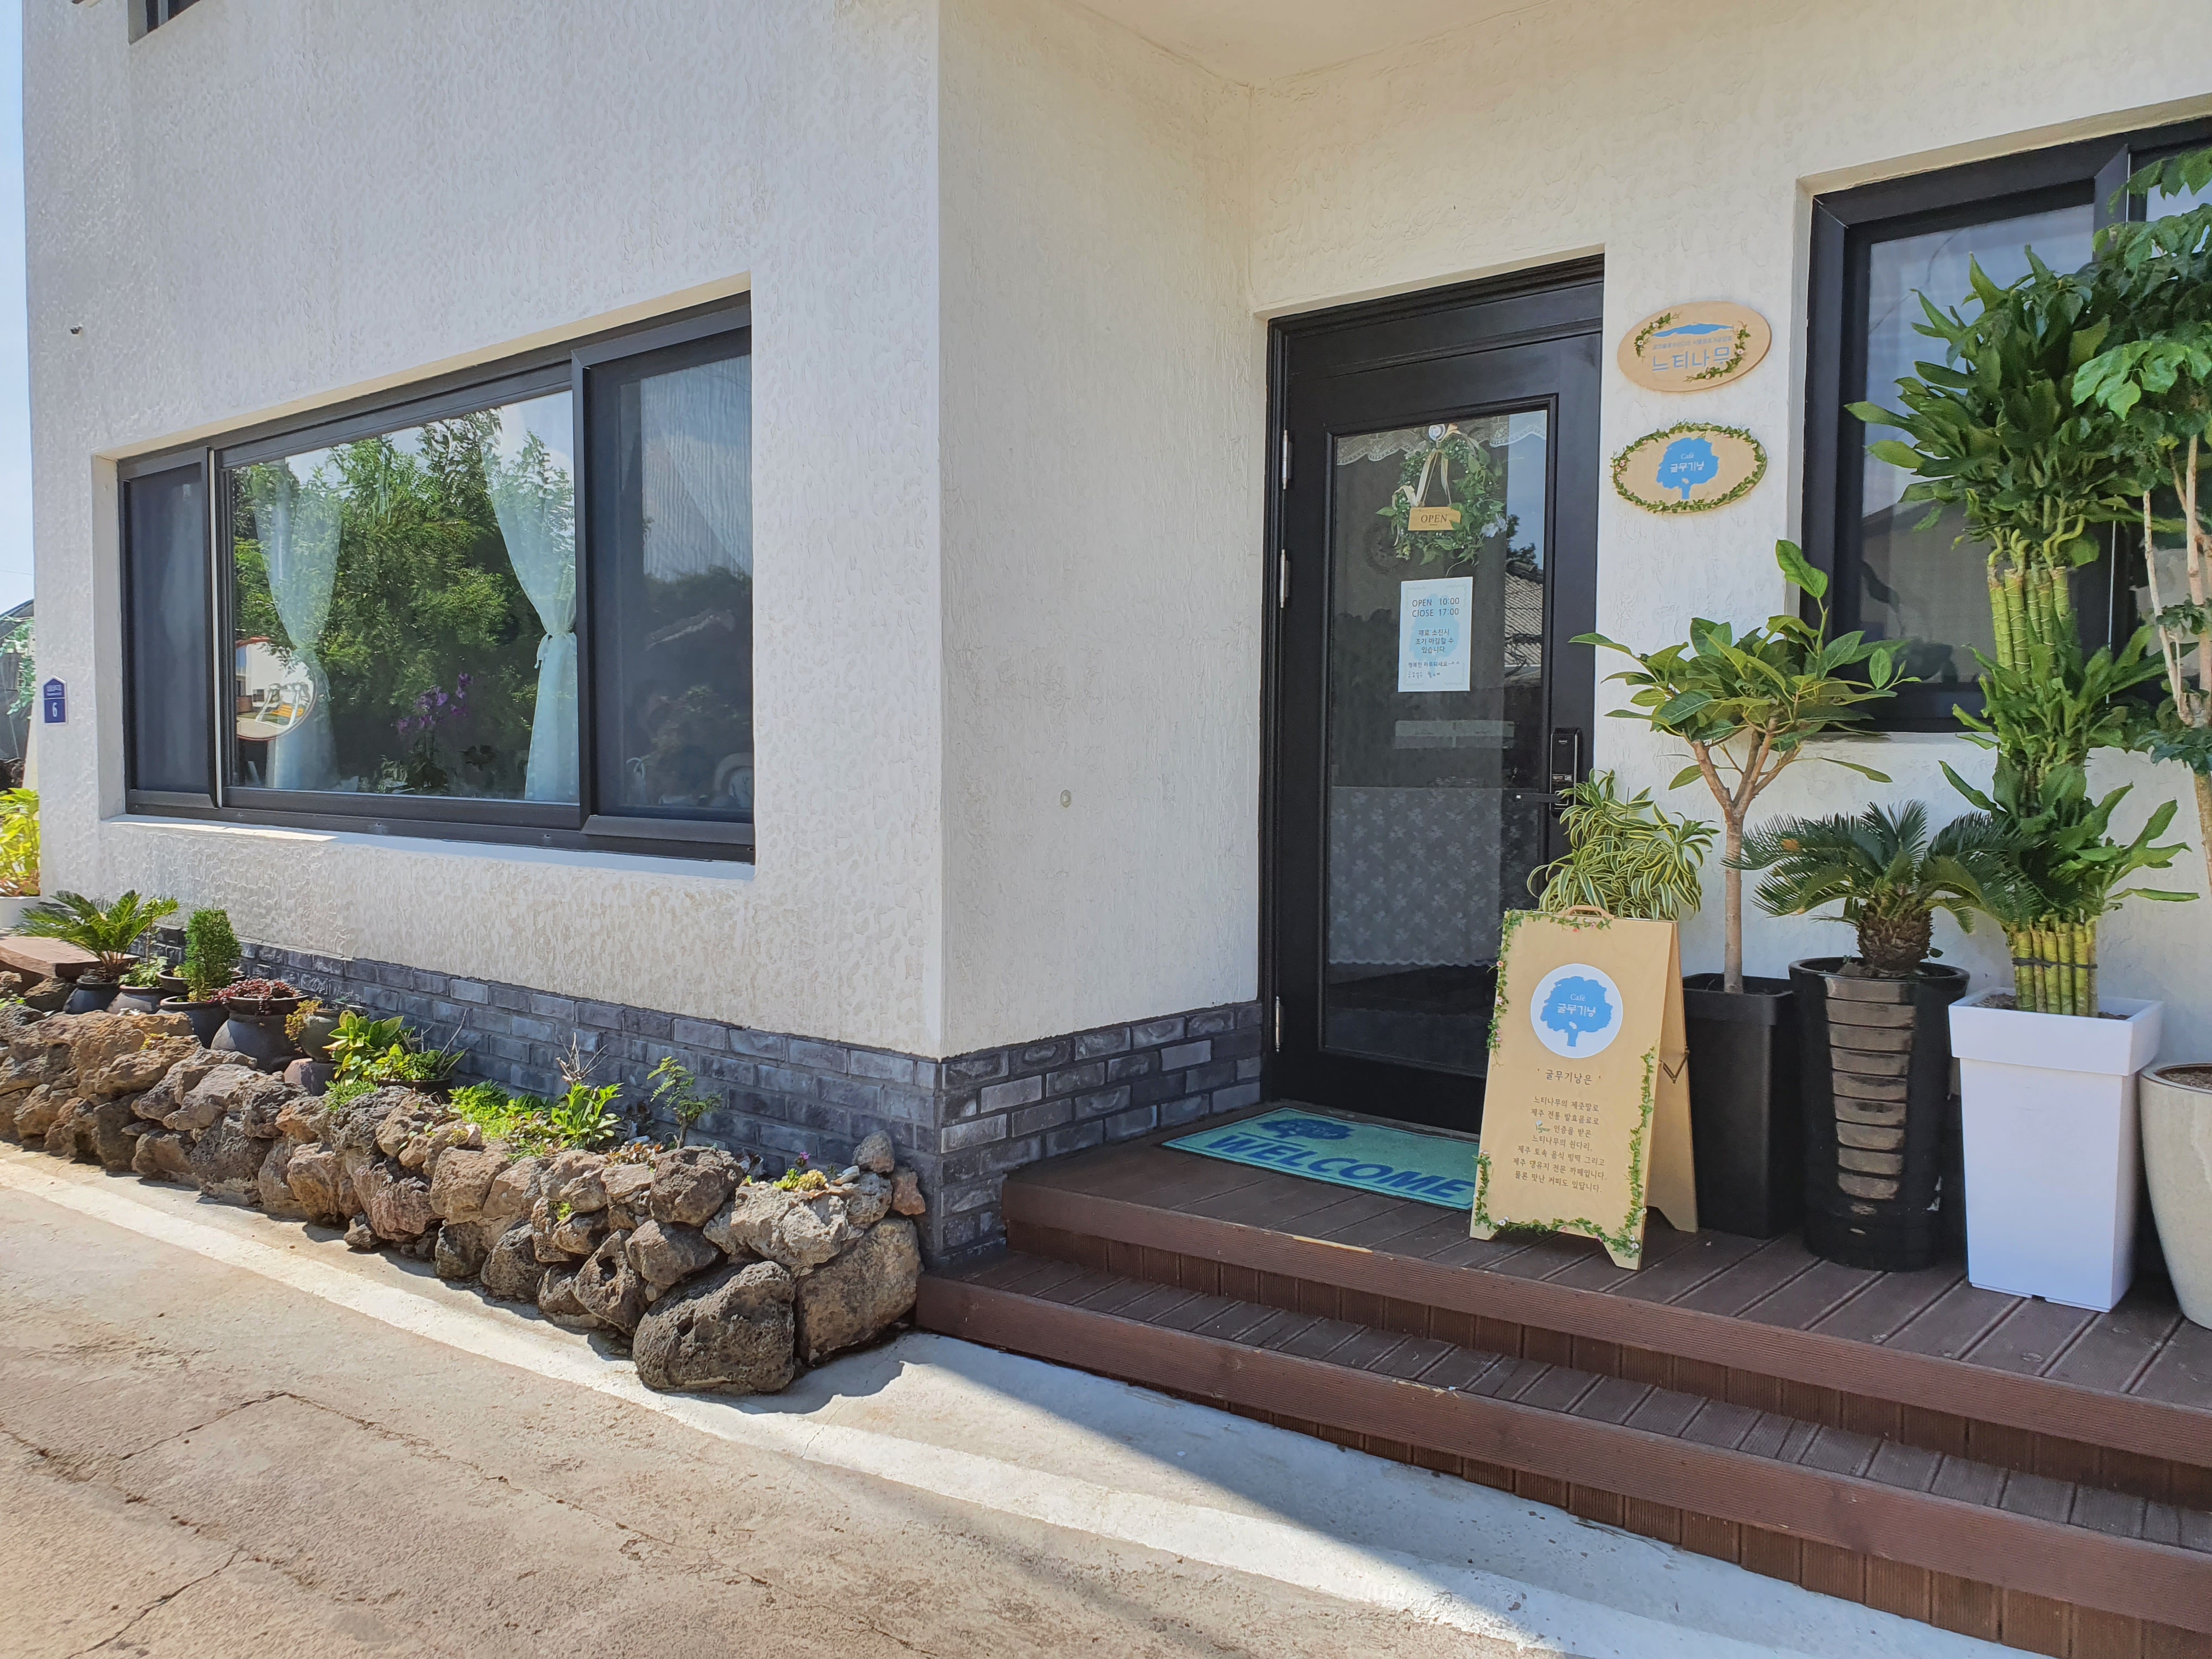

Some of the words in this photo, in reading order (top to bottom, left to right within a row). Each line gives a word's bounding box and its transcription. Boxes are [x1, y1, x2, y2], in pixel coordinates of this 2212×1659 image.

[1652, 346, 1730, 371] 느티나무
[1669, 461, 1705, 473] 굴무기낭
[1420, 514, 1448, 523] OPEN
[1412, 599, 1432, 607] OPEN
[1439, 597, 1460, 606] 10:00
[1438, 607, 1459, 616] 17:00
[52, 702, 58, 718] 6
[1556, 1003, 1596, 1017] 굴무기낭
[1533, 1096, 1568, 1108] 느티나무의
[1531, 1108, 1544, 1117] 제주
[1548, 1110, 1561, 1120] 전통
[1564, 1113, 1599, 1125] 발효음료로
[1554, 1125, 1574, 1136] 인증을
[1578, 1128, 1592, 1138] 받은
[1532, 1135, 1566, 1147] 느티나무의
[1517, 1145, 1531, 1154] 제주
[1534, 1148, 1548, 1157] 토속
[1551, 1150, 1564, 1160] 음식
[1567, 1153, 1581, 1163] 빙떡
[1584, 1156, 1605, 1166] 그리고
[1205, 1134, 1475, 1198] WELCOME
[1513, 1158, 1526, 1167] 제주
[1553, 1164, 1566, 1173] 전문
[1515, 1170, 1528, 1181] 물론
[1548, 1176, 1568, 1187] 커피도
[1572, 1180, 1602, 1193] 있답니다.
